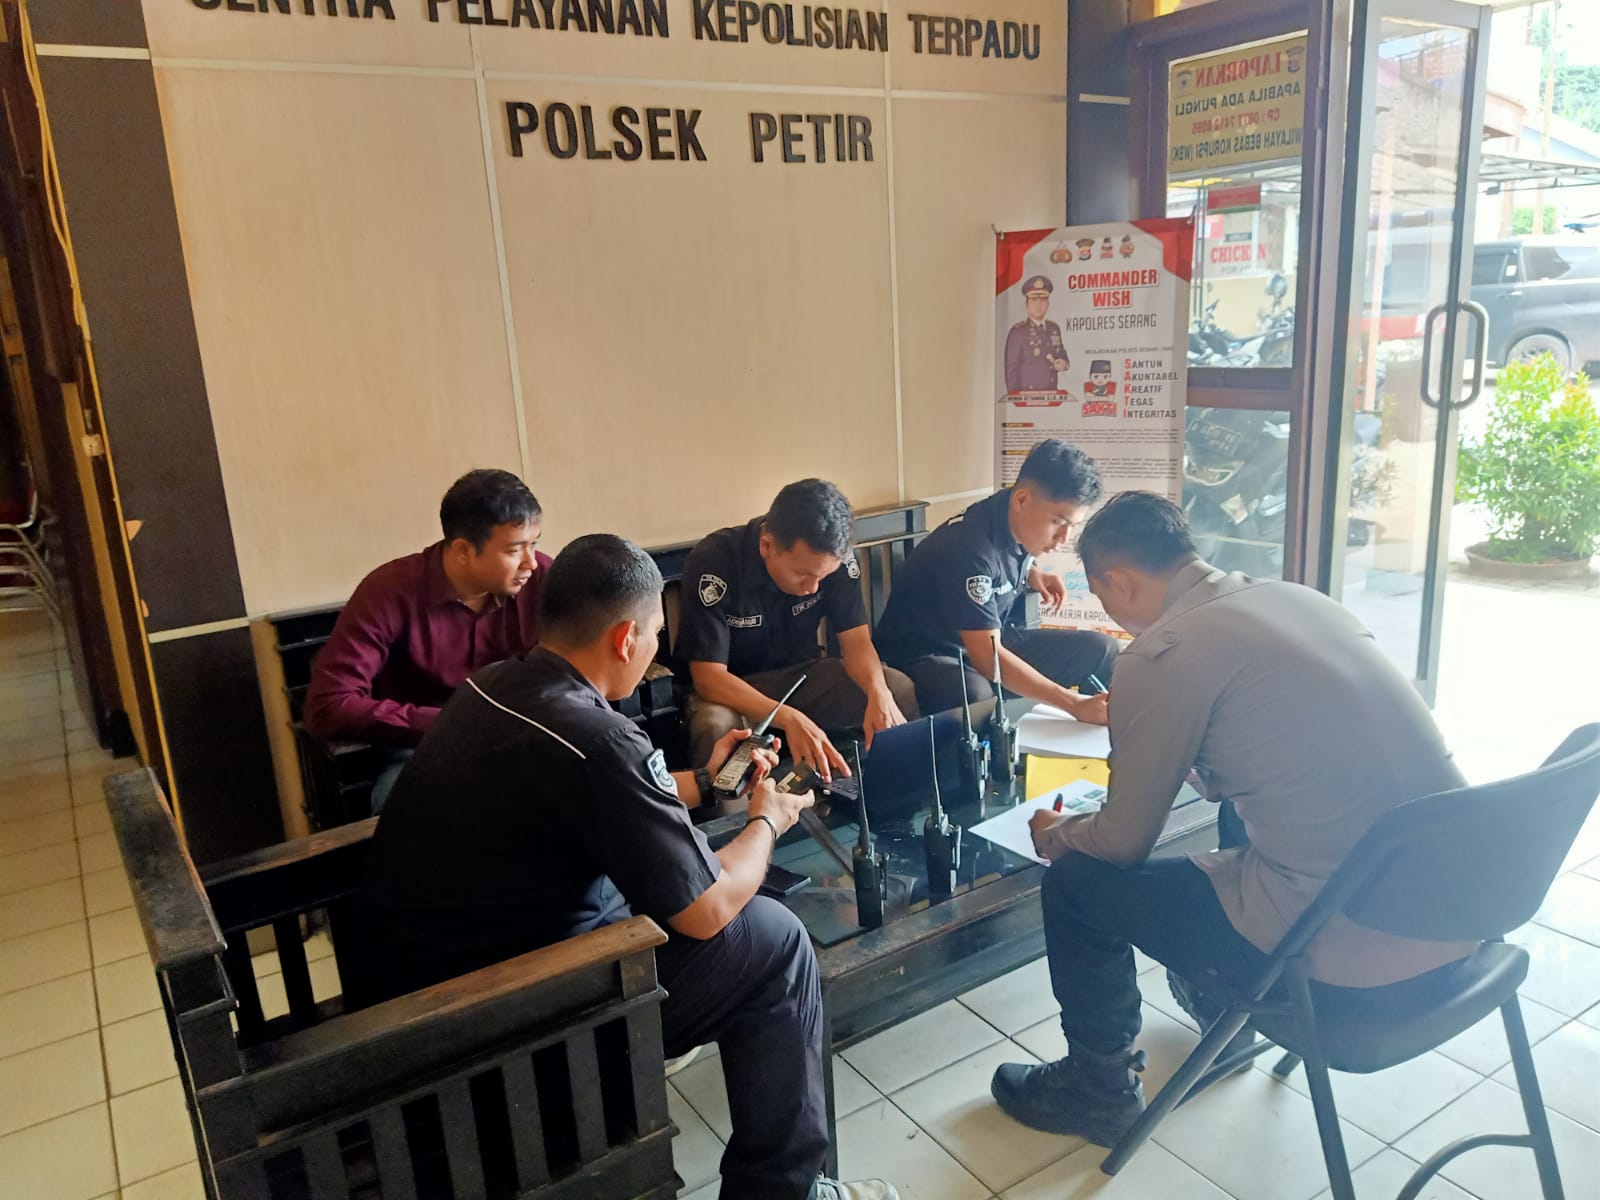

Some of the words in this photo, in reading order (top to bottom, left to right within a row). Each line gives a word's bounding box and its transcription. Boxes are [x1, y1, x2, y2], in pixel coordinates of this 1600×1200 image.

[694, 0, 888, 52] KEPOLISIAN
[908, 13, 1040, 60] TERPADU
[506, 101, 707, 161] POLSEK
[748, 111, 874, 163] PETIR
[1210, 244, 1267, 264] CHICKN
[1068, 269, 1158, 290] COMMANDER
[1092, 290, 1131, 307] WISH
[1066, 315, 1115, 331] KAPOLRES
[1118, 313, 1157, 329] SERANG
[1124, 358, 1162, 369] SANTUN
[1124, 371, 1178, 382] AKUNTABEL
[1124, 384, 1162, 394] KREATIF
[1124, 396, 1153, 407] TEGAS
[1123, 409, 1177, 419] INTEGRITAS
